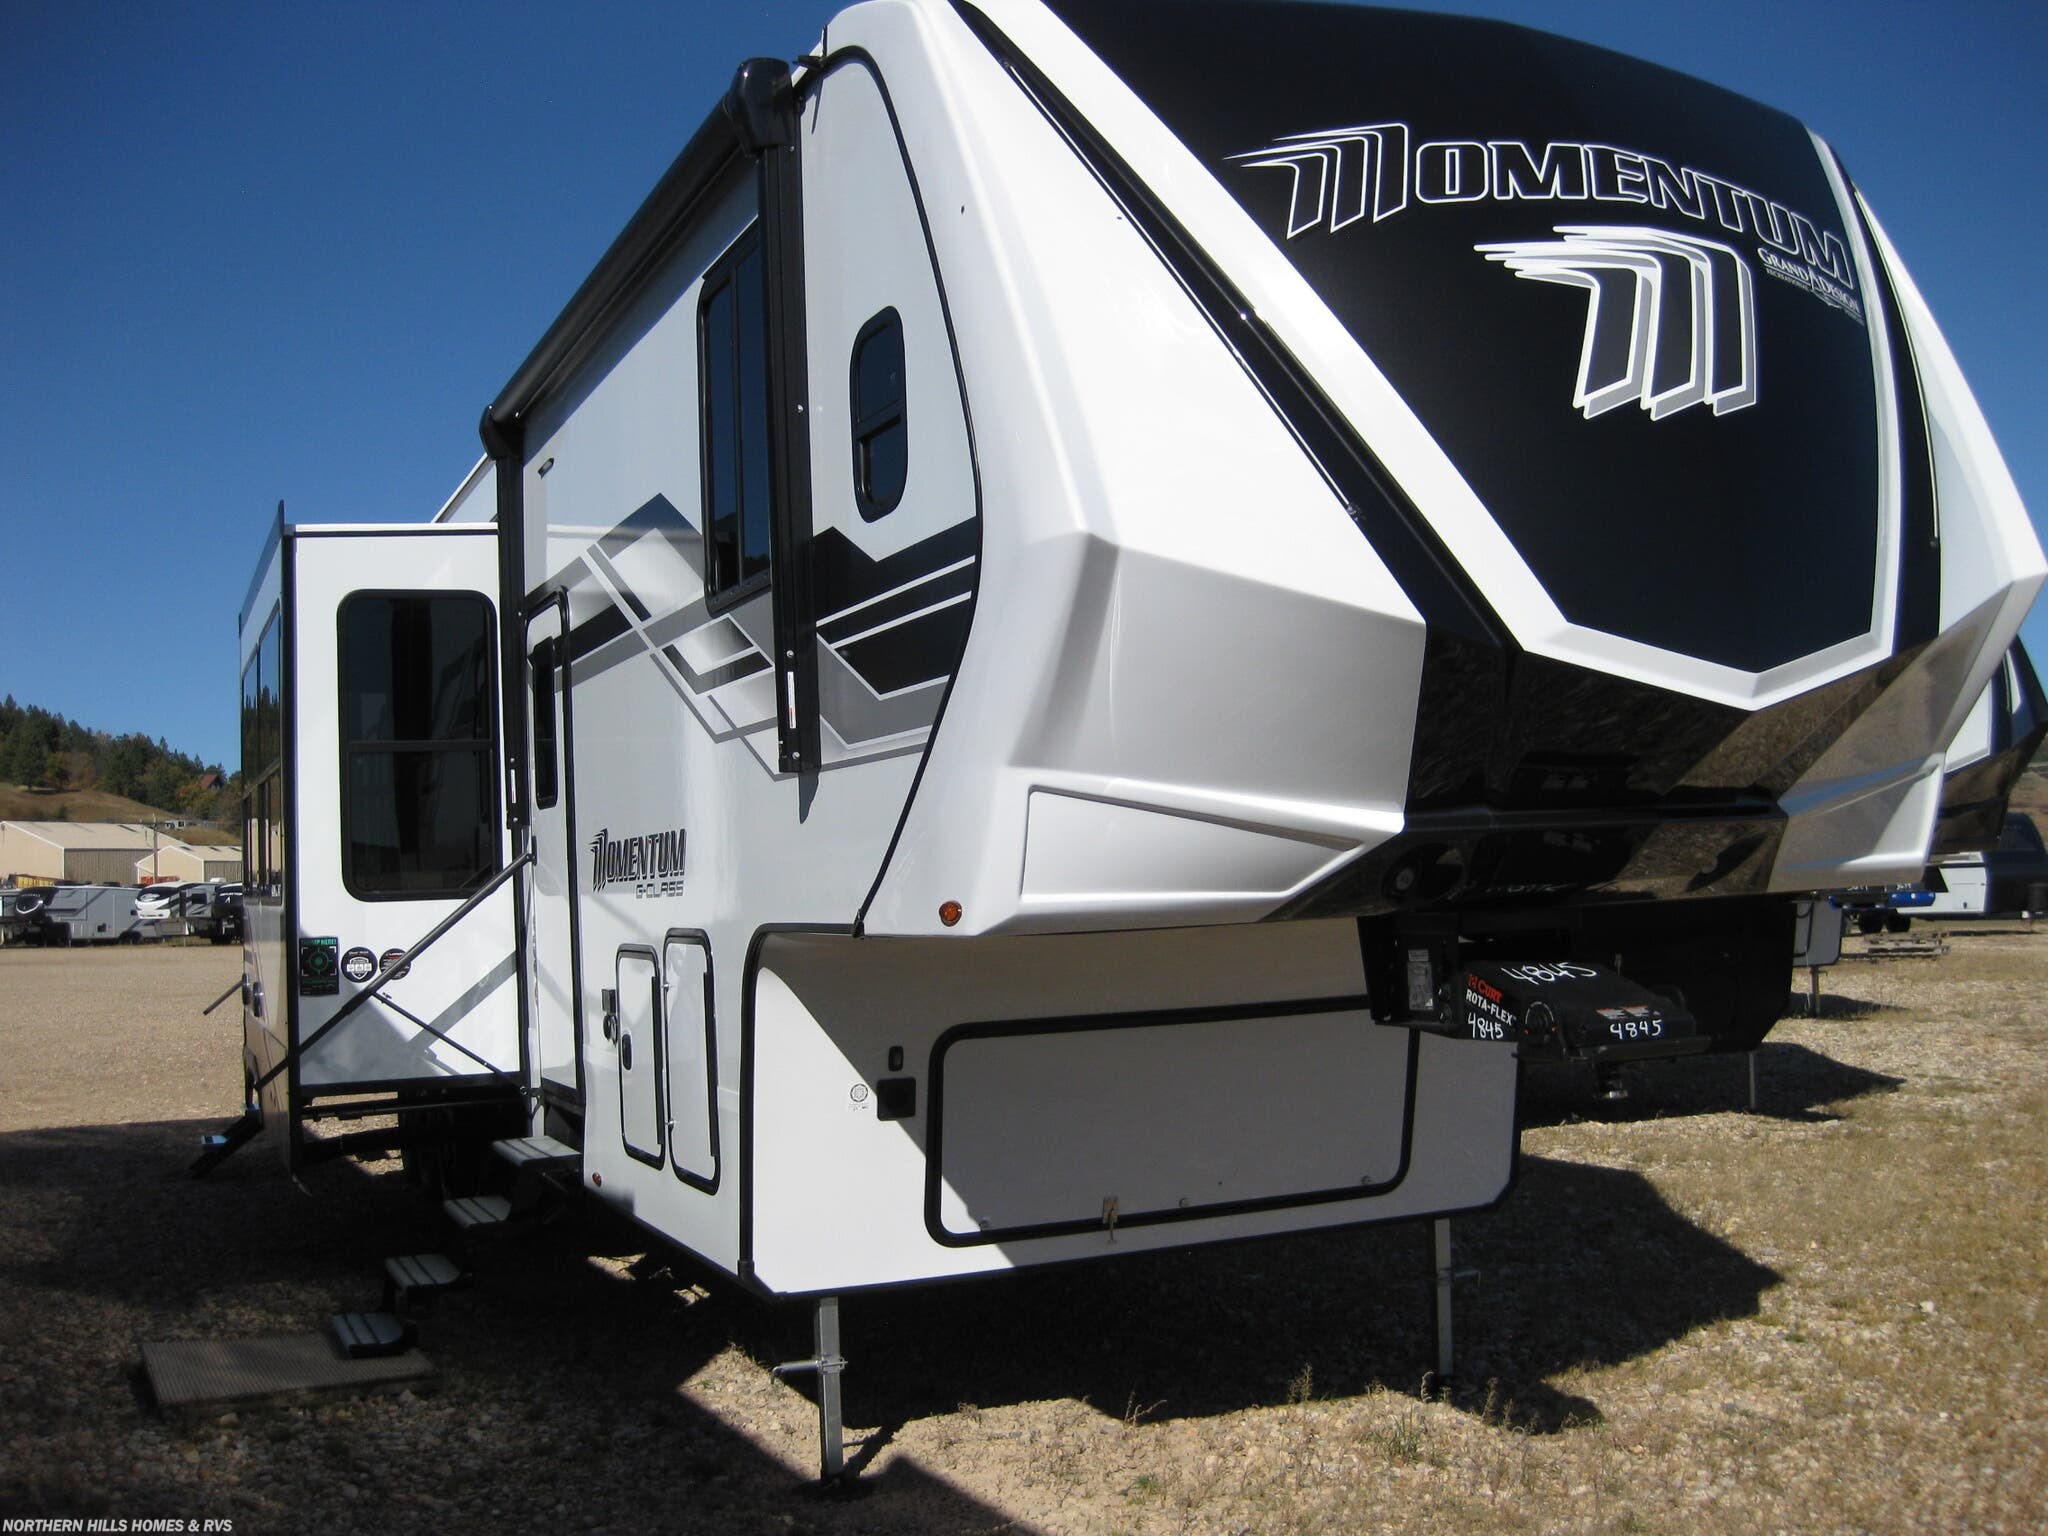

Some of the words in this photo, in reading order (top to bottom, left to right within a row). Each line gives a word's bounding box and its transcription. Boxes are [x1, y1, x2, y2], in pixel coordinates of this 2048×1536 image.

[1222, 122, 1855, 292] MOMENTUM
[1757, 247, 1810, 282] GRAND
[1816, 274, 1861, 314] DESIGN
[588, 827, 688, 894] MOMENTUM
[635, 880, 685, 899] G-CLASS
[1500, 961, 1599, 986] 4845
[1464, 987, 1513, 1027] ROTA-FLEX
[1466, 1011, 1505, 1041] 4845
[1609, 1018, 1663, 1040] 4845
